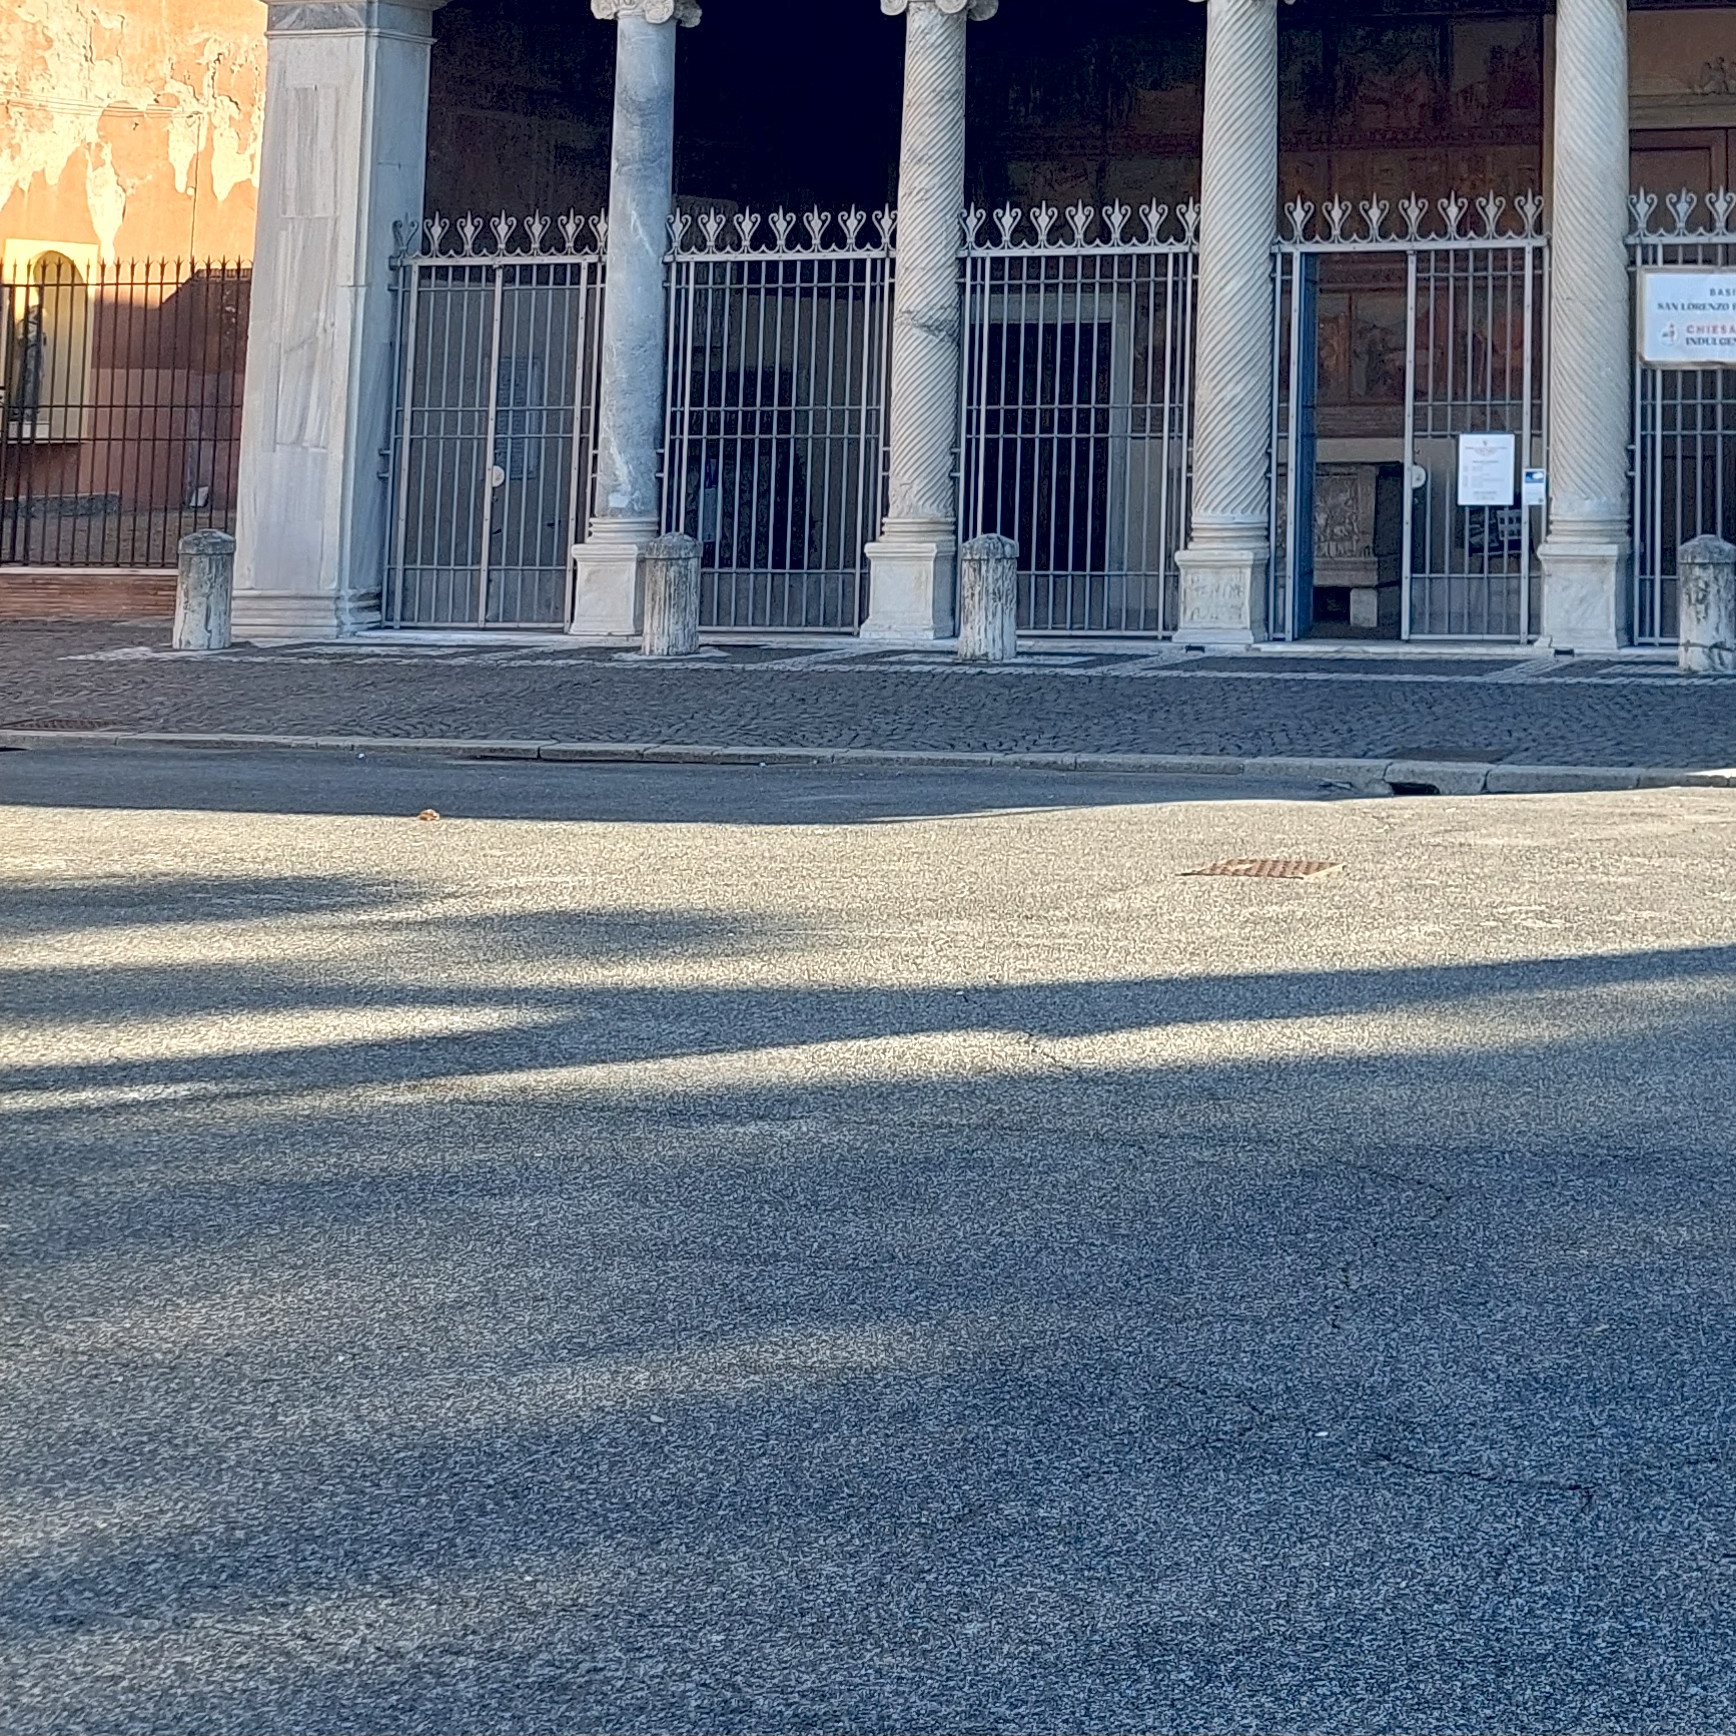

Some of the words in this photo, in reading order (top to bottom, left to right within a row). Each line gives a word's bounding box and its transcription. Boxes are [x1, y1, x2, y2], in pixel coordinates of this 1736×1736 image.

[1657, 302, 1679, 311] SAN
[1681, 302, 1730, 311] LORENZO
[1686, 324, 1736, 334] CHIESA
